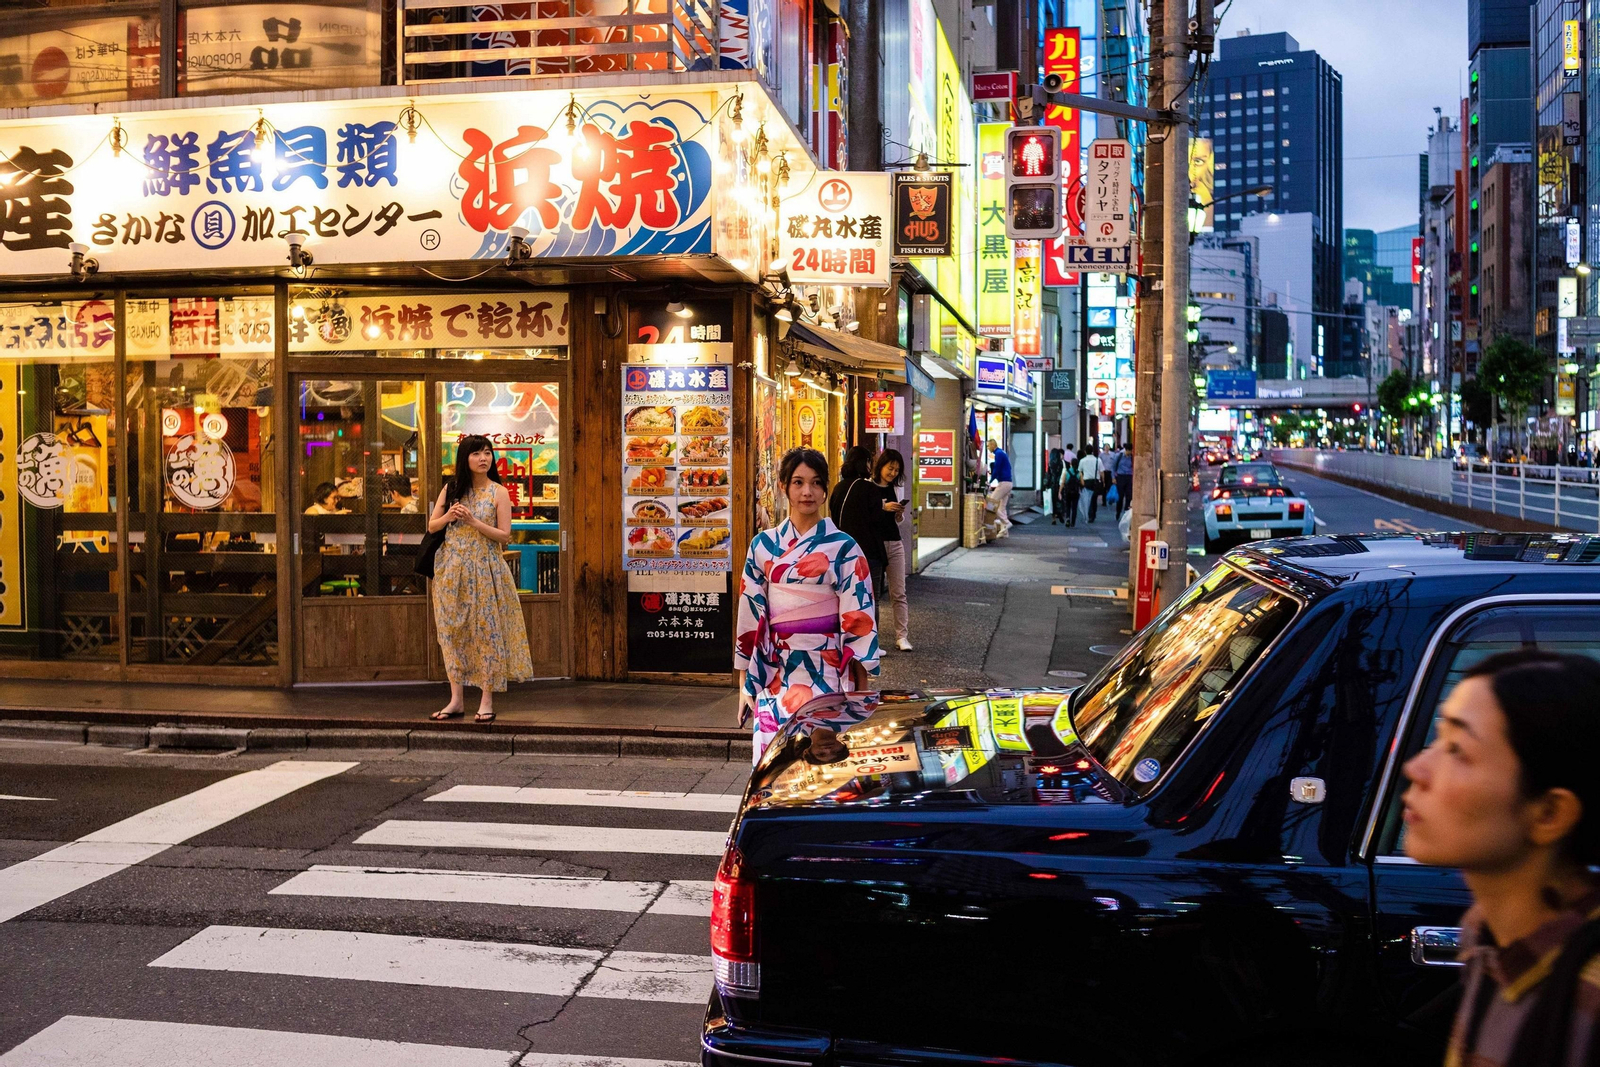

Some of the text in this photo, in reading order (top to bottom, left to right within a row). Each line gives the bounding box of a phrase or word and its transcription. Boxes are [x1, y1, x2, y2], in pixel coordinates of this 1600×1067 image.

[142, 120, 398, 198] 鮮魚貝類
[1094, 144, 1125, 158] 買取
[458, 120, 680, 232] 浜焼
[1096, 159, 1109, 212] タマリヤ
[91, 211, 186, 246] さかな
[241, 201, 444, 246] 加工センター
[786, 213, 882, 240] 磯丸水産
[904, 220, 940, 241] HUB
[982, 199, 1009, 294] 大黒屋
[791, 247, 876, 274] 24時間
[648, 369, 727, 389] 磯丸水産
[869, 400, 891, 415] 82
[920, 446, 949, 454] コーナー
[665, 592, 720, 606] 磯丸水産
[658, 616, 704, 628] 六本木店
[654, 631, 715, 639] 03-5413-7951
